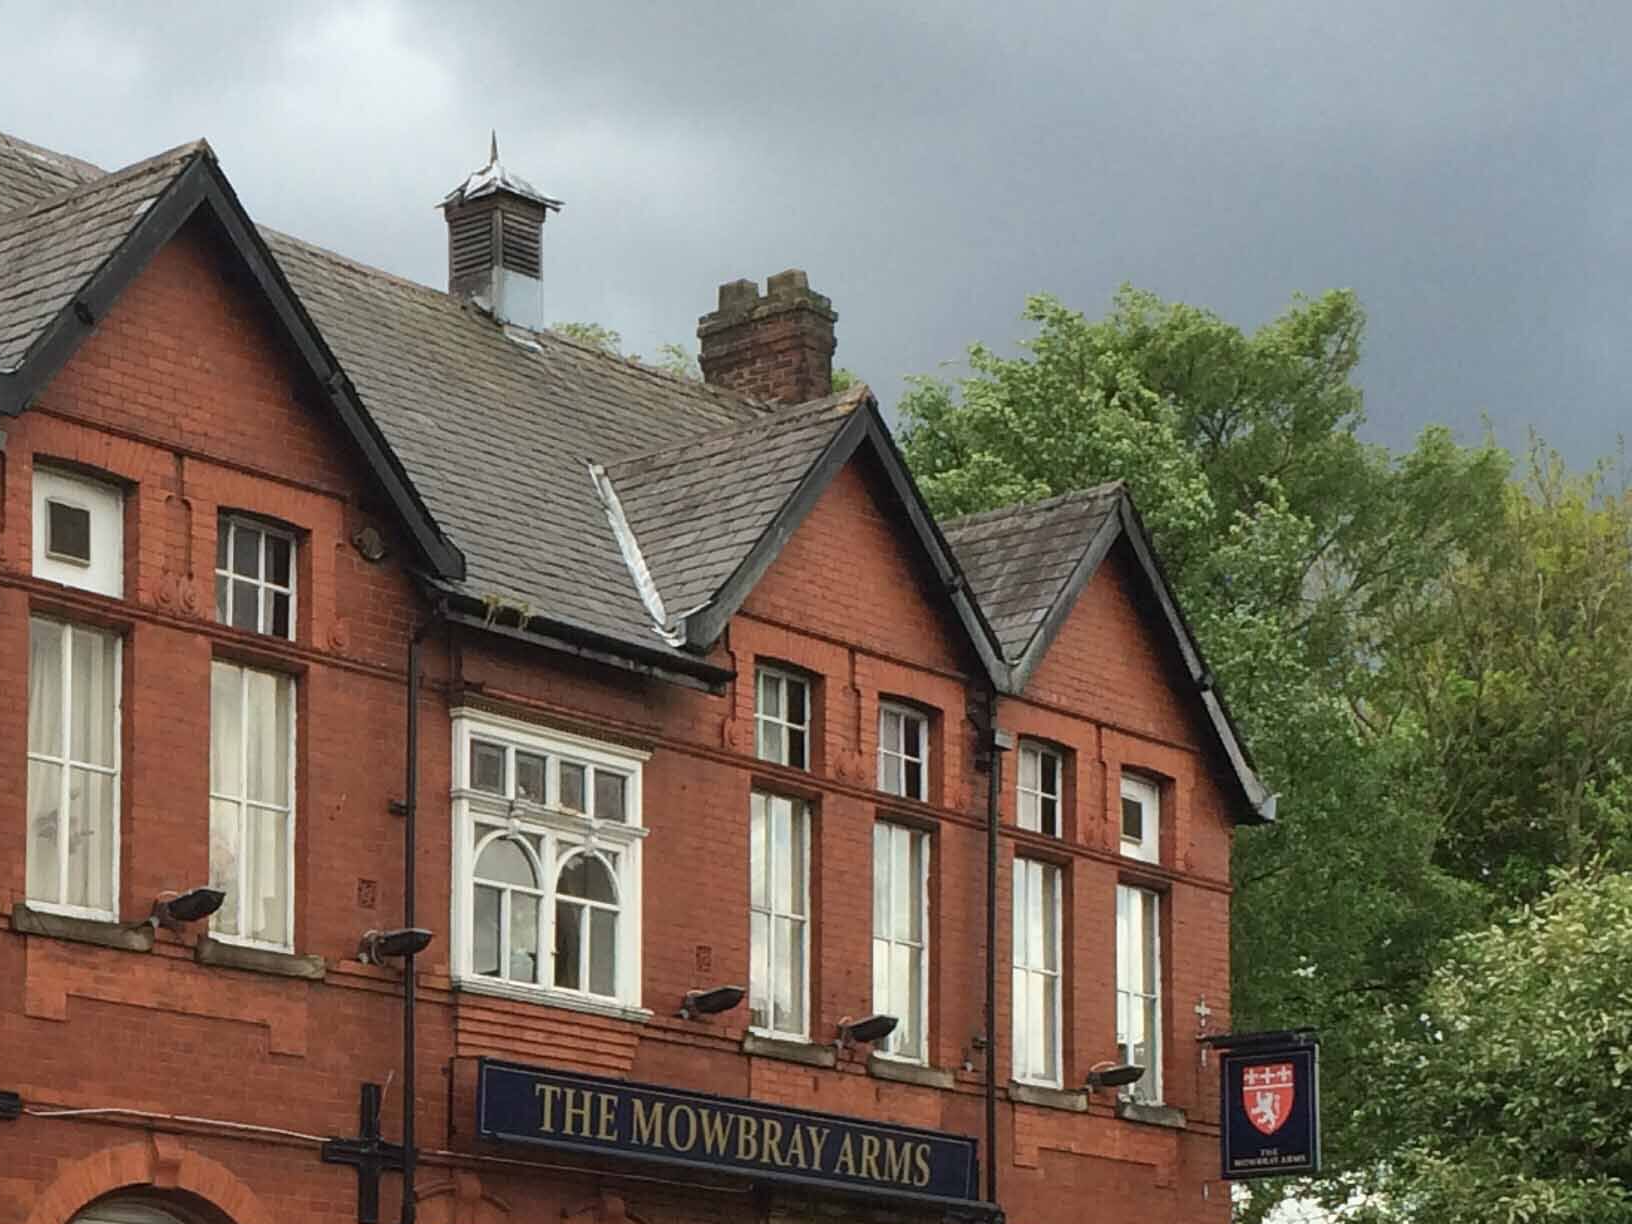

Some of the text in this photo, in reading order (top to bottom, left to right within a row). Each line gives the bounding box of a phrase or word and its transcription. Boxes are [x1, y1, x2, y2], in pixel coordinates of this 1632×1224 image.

[535, 1082, 931, 1188] THE MOWBRAY ARMS
